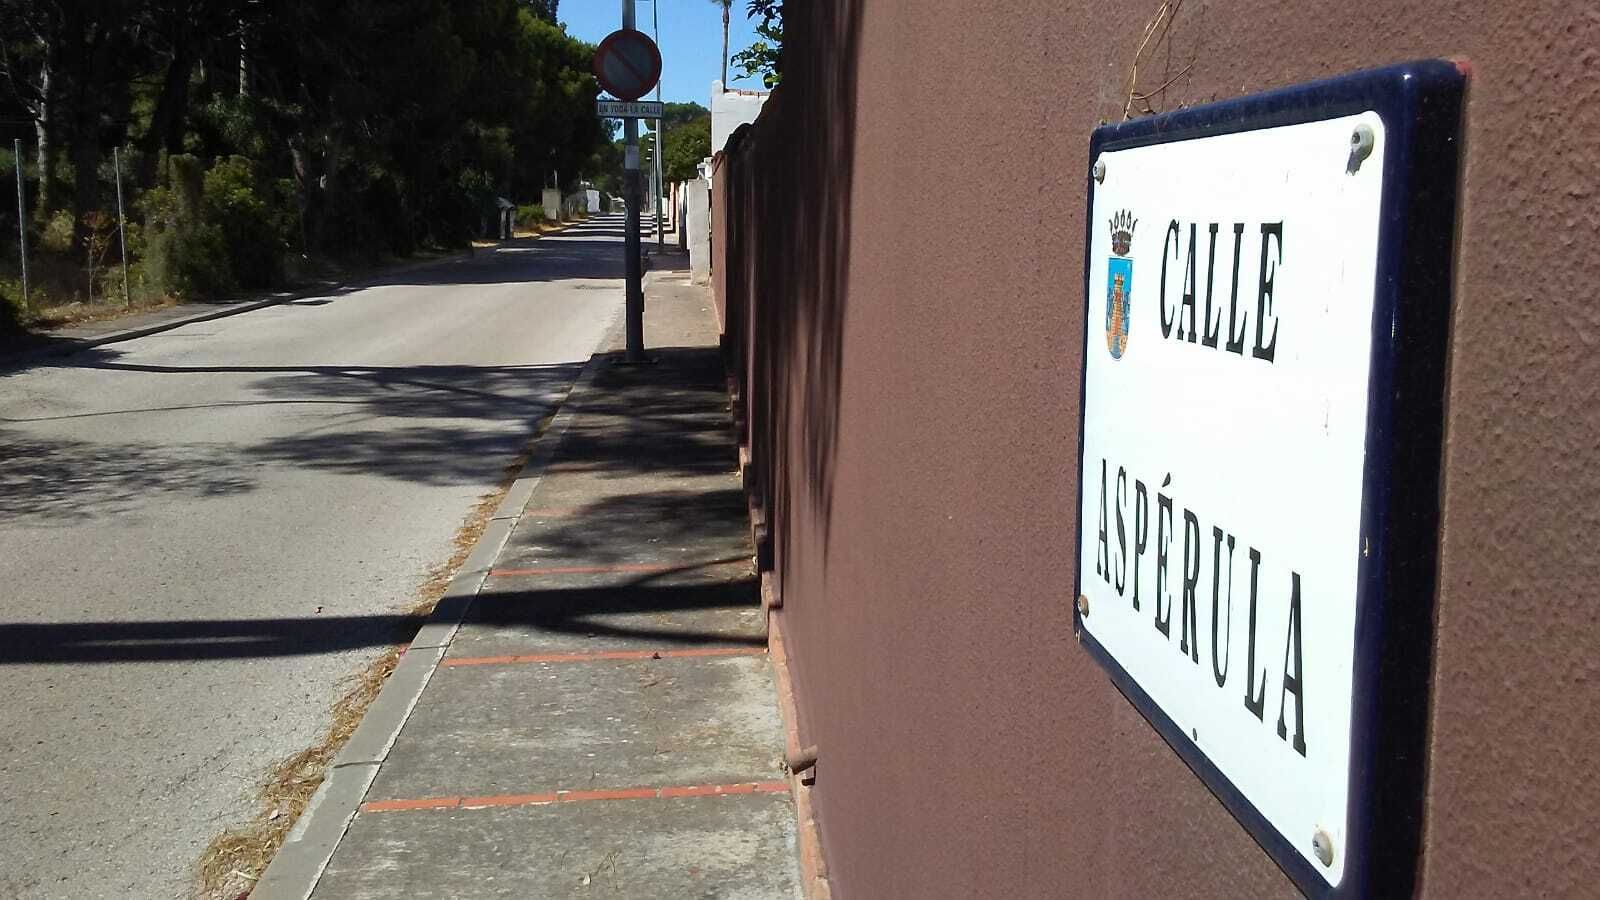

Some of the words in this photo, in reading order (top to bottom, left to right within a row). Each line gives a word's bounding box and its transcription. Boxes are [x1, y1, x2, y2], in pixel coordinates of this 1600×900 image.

[641, 104, 661, 113] CALLE
[1160, 218, 1284, 364] CALLE
[1096, 458, 1307, 758] ASPÉRULA
